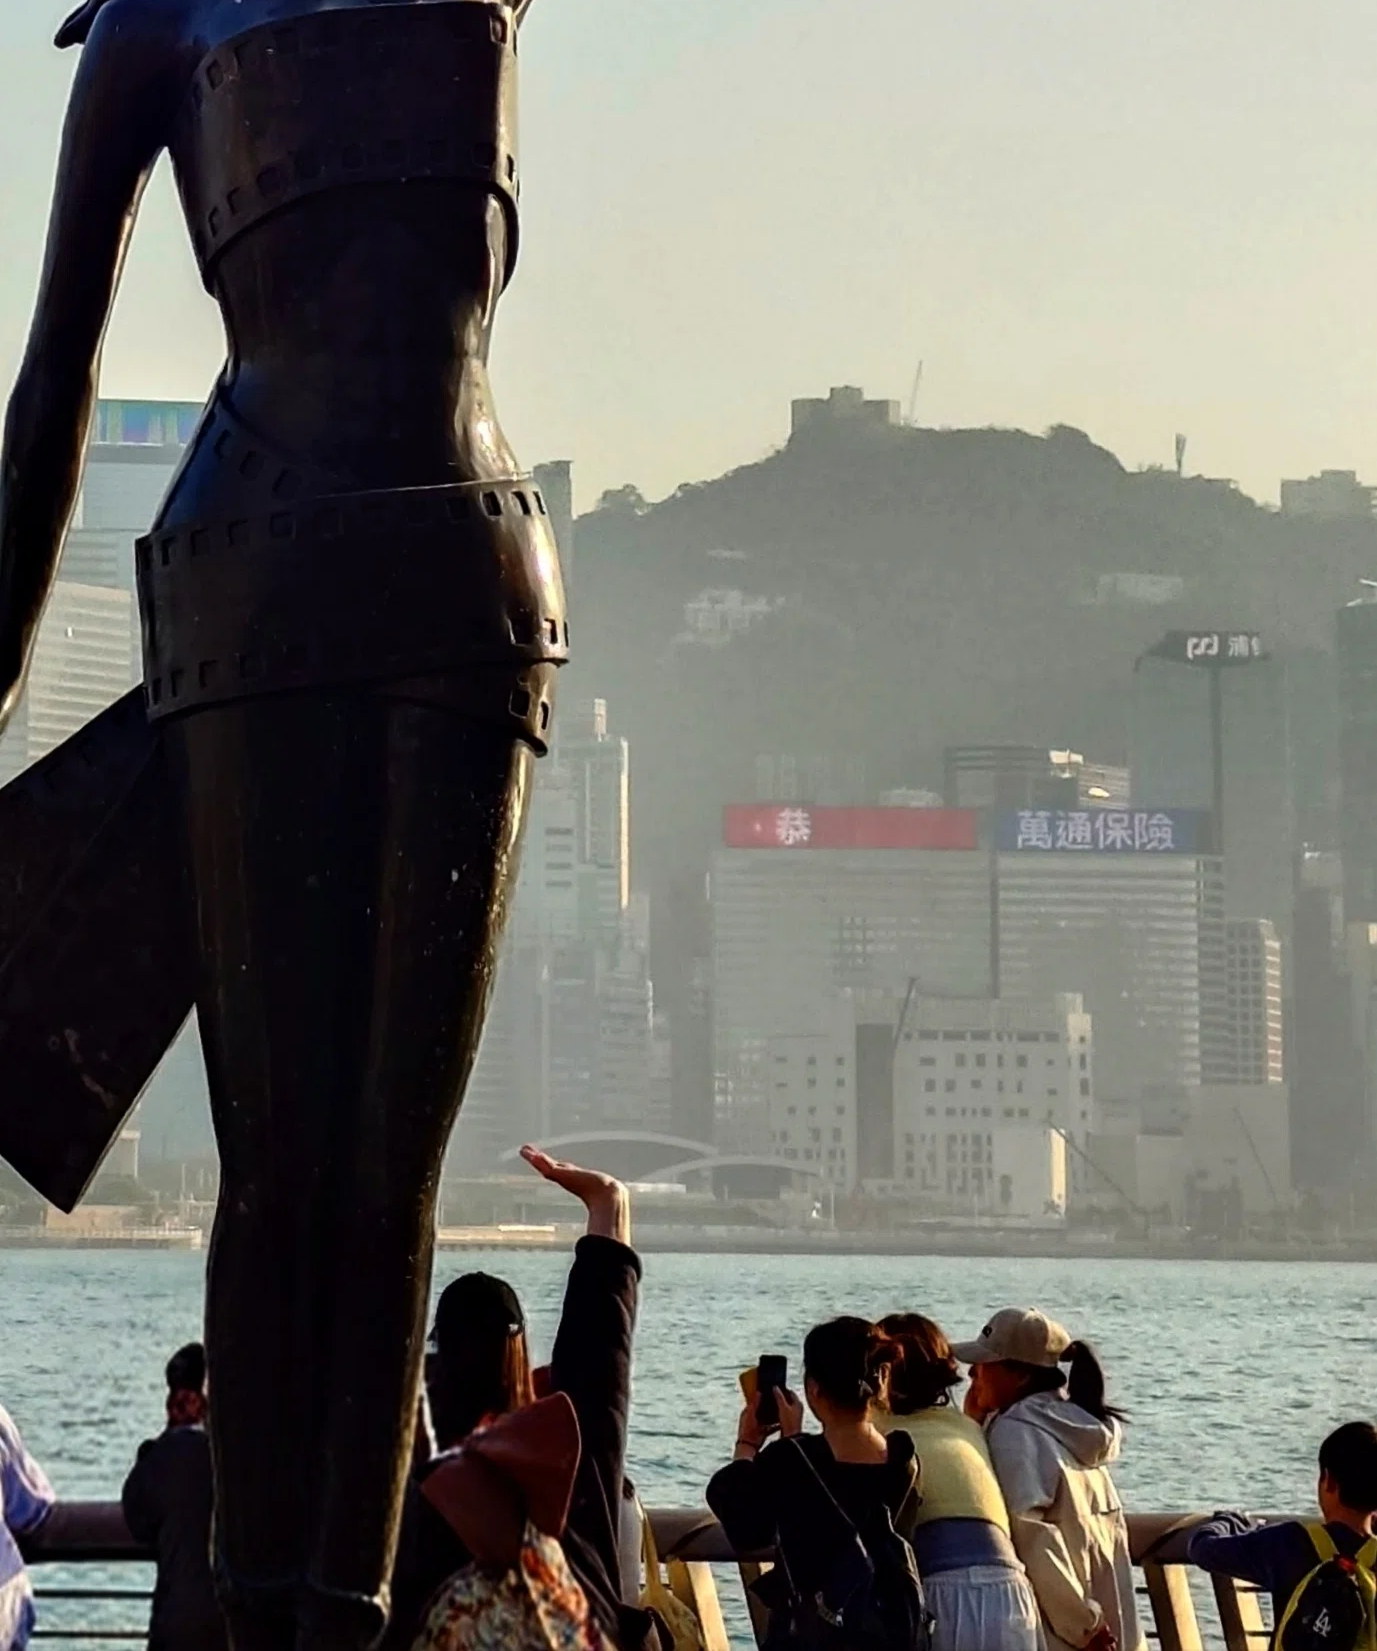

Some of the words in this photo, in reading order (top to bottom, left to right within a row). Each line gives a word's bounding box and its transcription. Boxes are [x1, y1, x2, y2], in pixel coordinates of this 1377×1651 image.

[775, 807, 812, 845] 恭
[1016, 810, 1175, 850] 萬通保險
